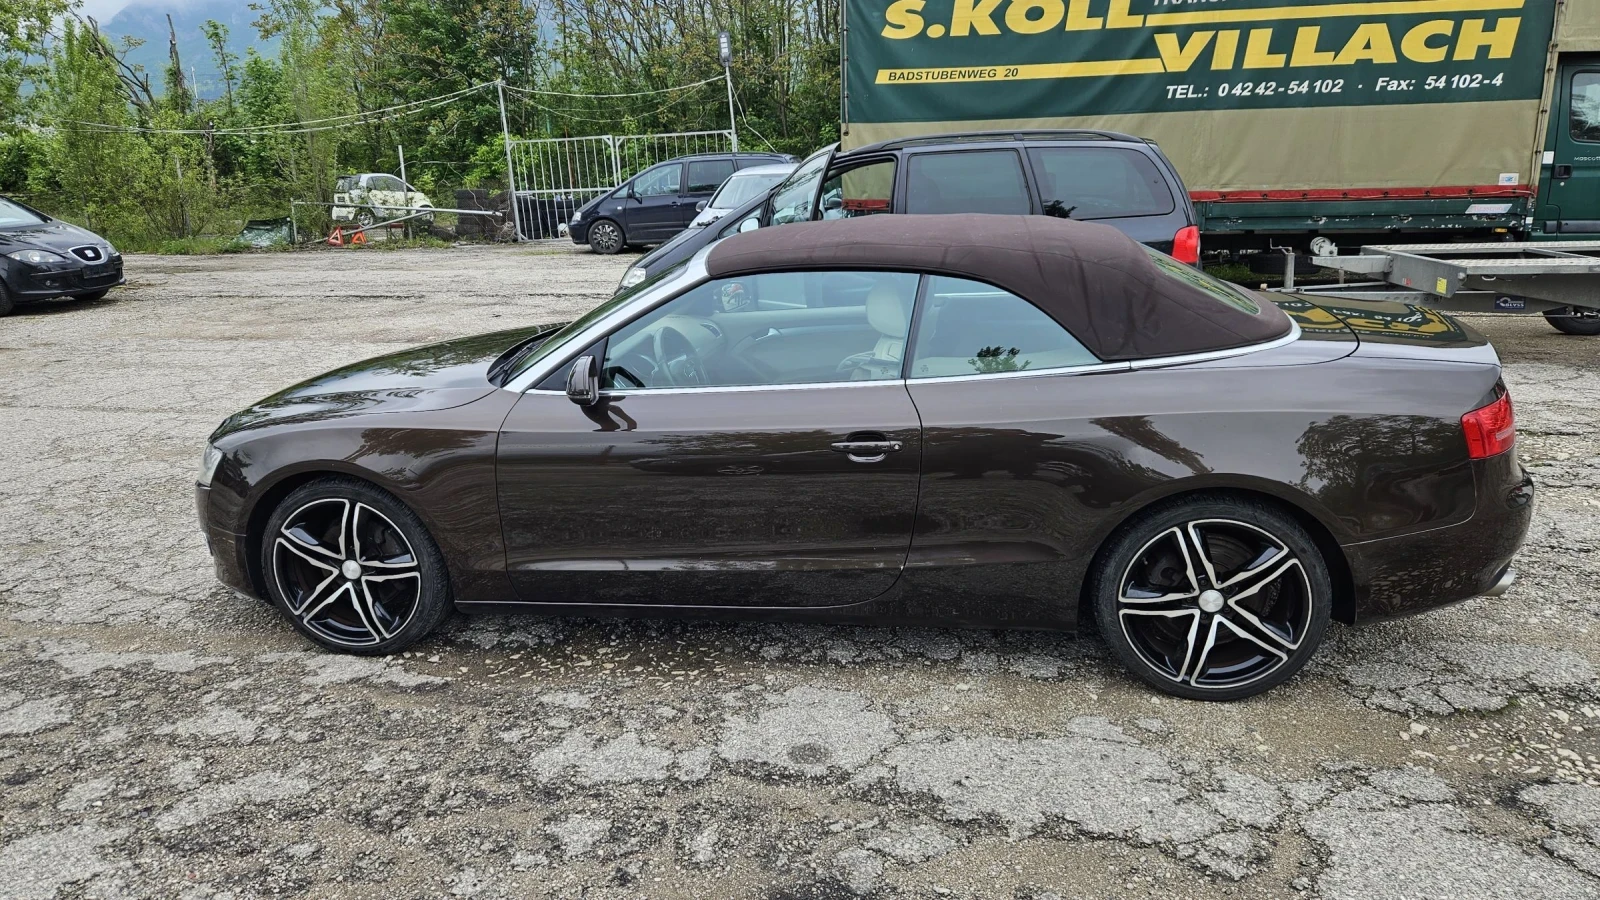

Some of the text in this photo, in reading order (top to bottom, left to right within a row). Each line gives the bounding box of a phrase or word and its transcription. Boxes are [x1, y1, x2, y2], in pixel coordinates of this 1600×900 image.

[1154, 16, 1522, 73] VILLACH
[888, 68, 1019, 81] BADSTUBENWEG 20
[1166, 85, 1209, 99] TEL.:
[1375, 77, 1416, 91] Fax:
